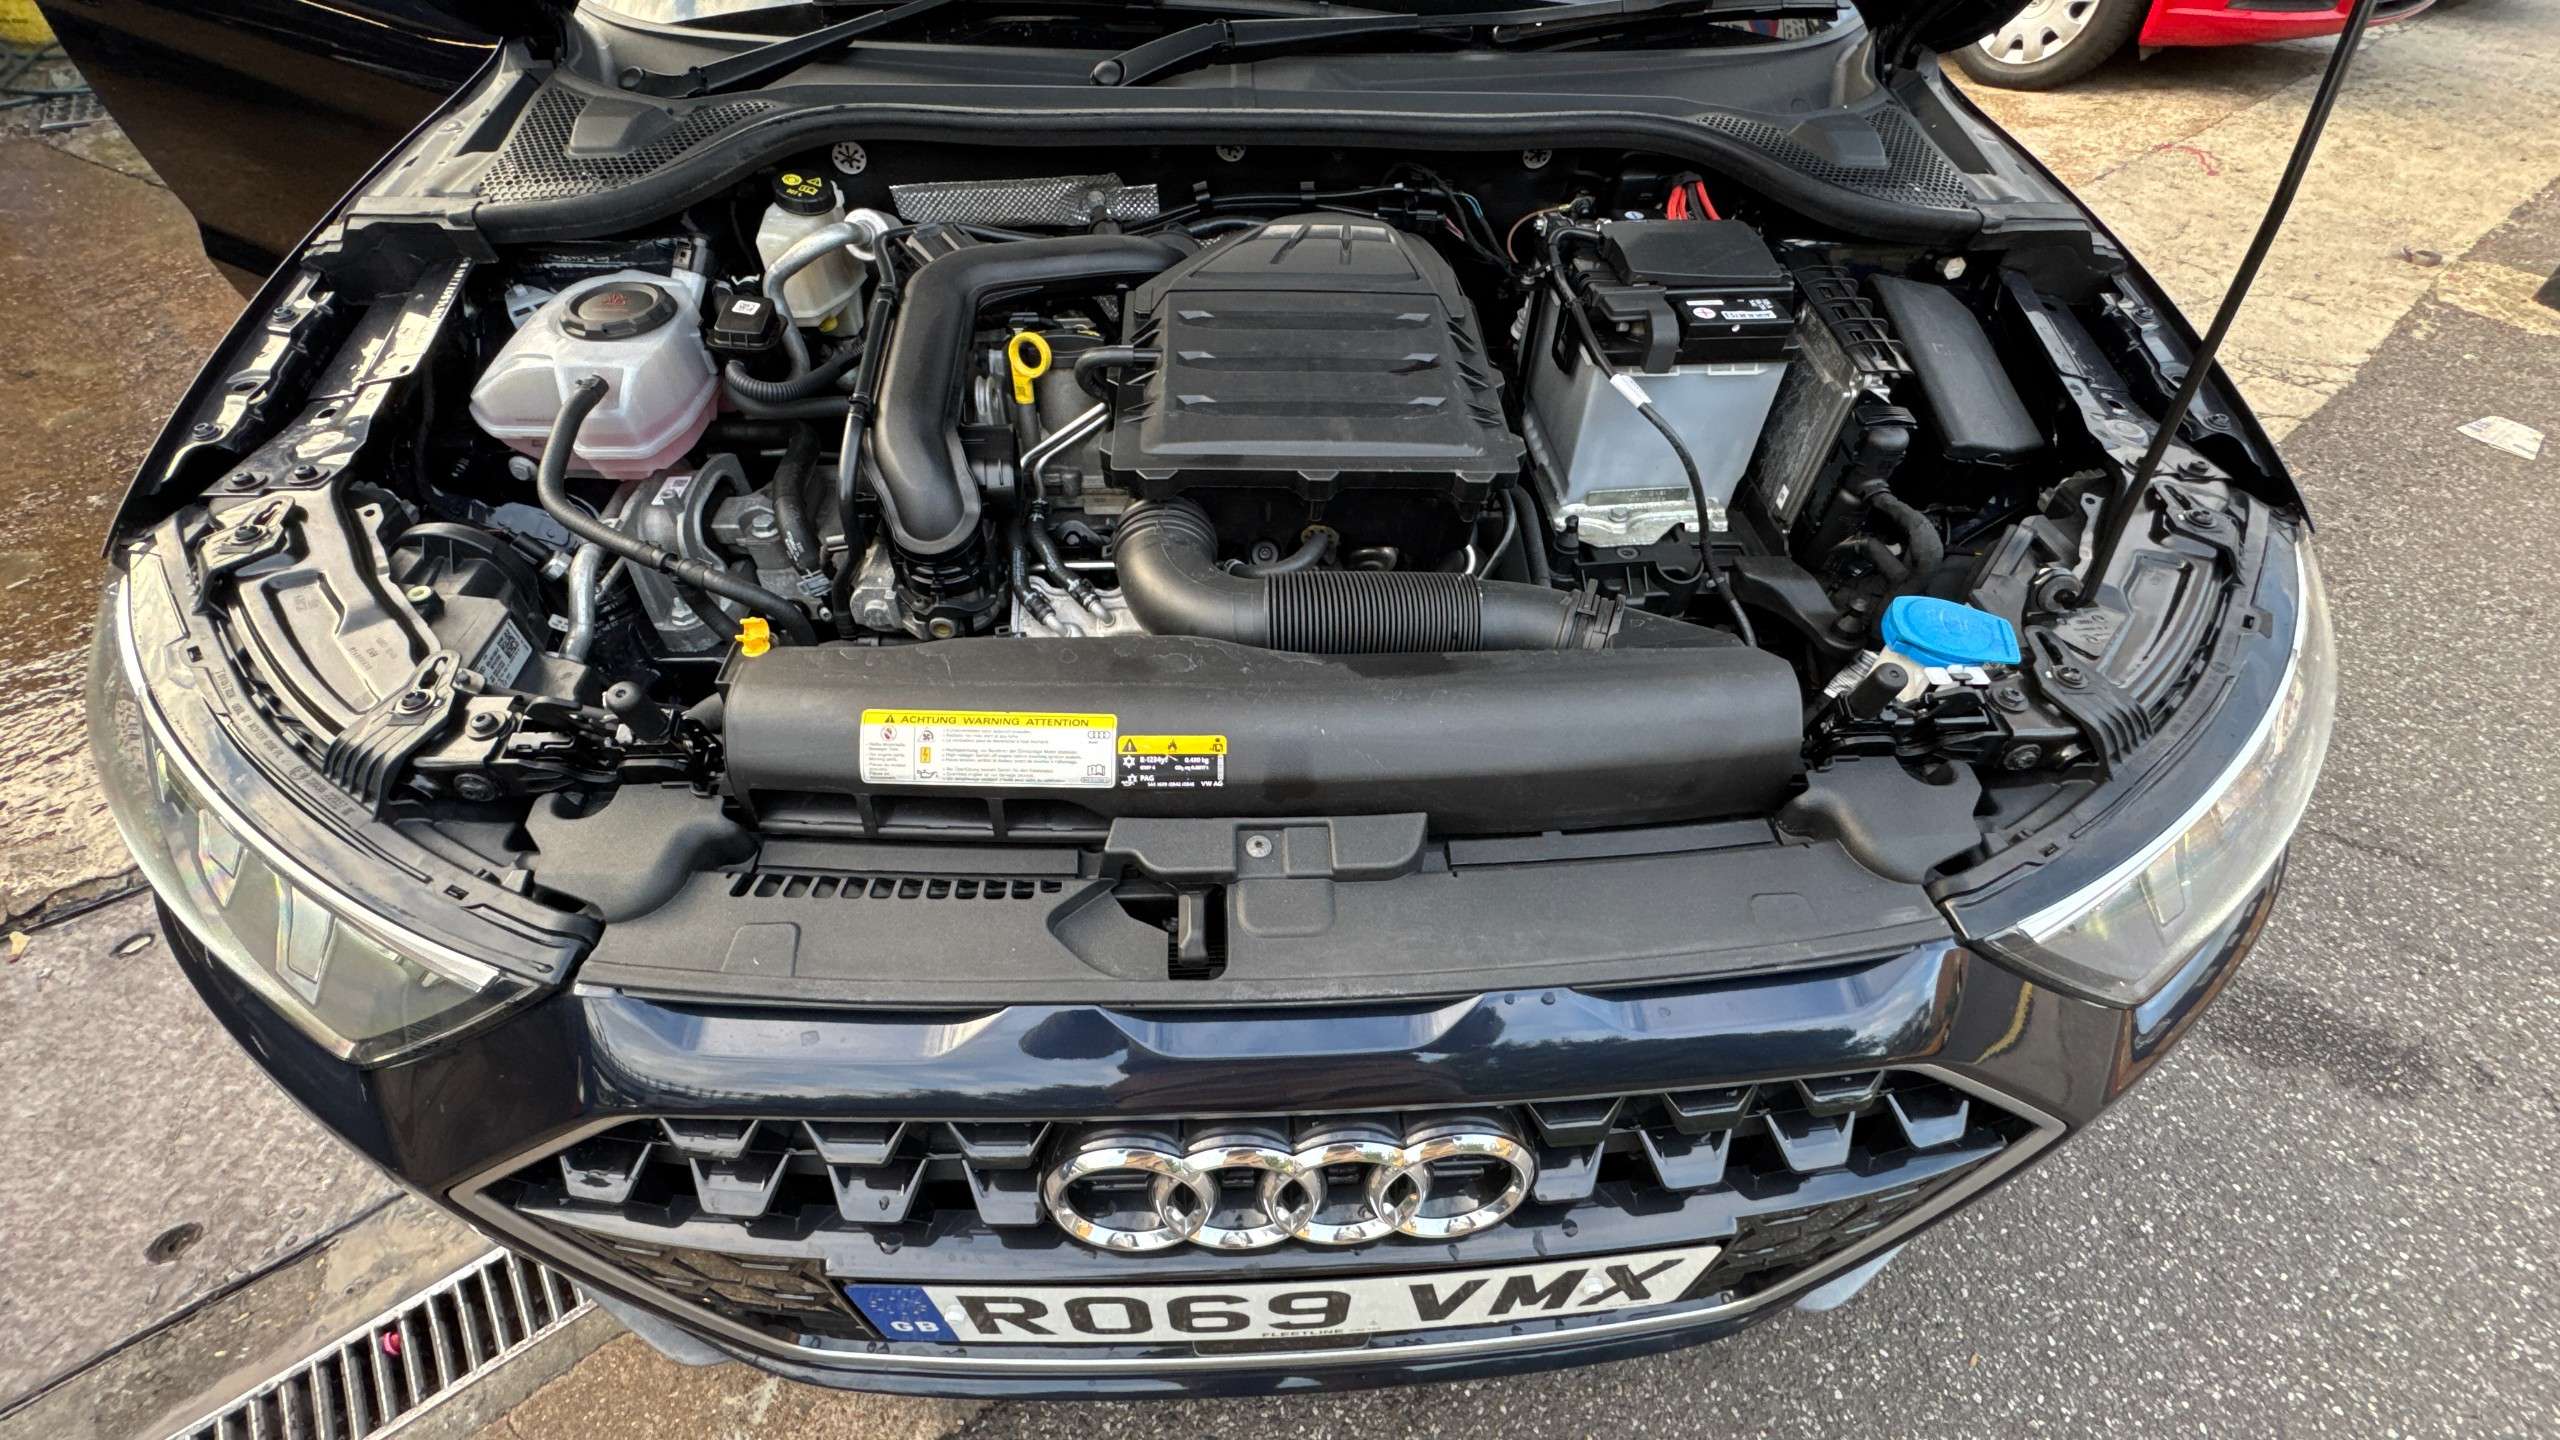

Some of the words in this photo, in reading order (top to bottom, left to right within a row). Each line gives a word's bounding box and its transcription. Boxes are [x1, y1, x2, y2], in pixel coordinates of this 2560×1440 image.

[900, 715, 957, 724] ACHTUNG
[963, 717, 1020, 726] WARNING
[1025, 718, 1089, 727] ATTENTION
[956, 1290, 1352, 1335] RO69
[1409, 1258, 1685, 1322] VMX
[890, 1321, 940, 1333] GB
[1261, 1329, 1344, 1338] FLEETLINE
